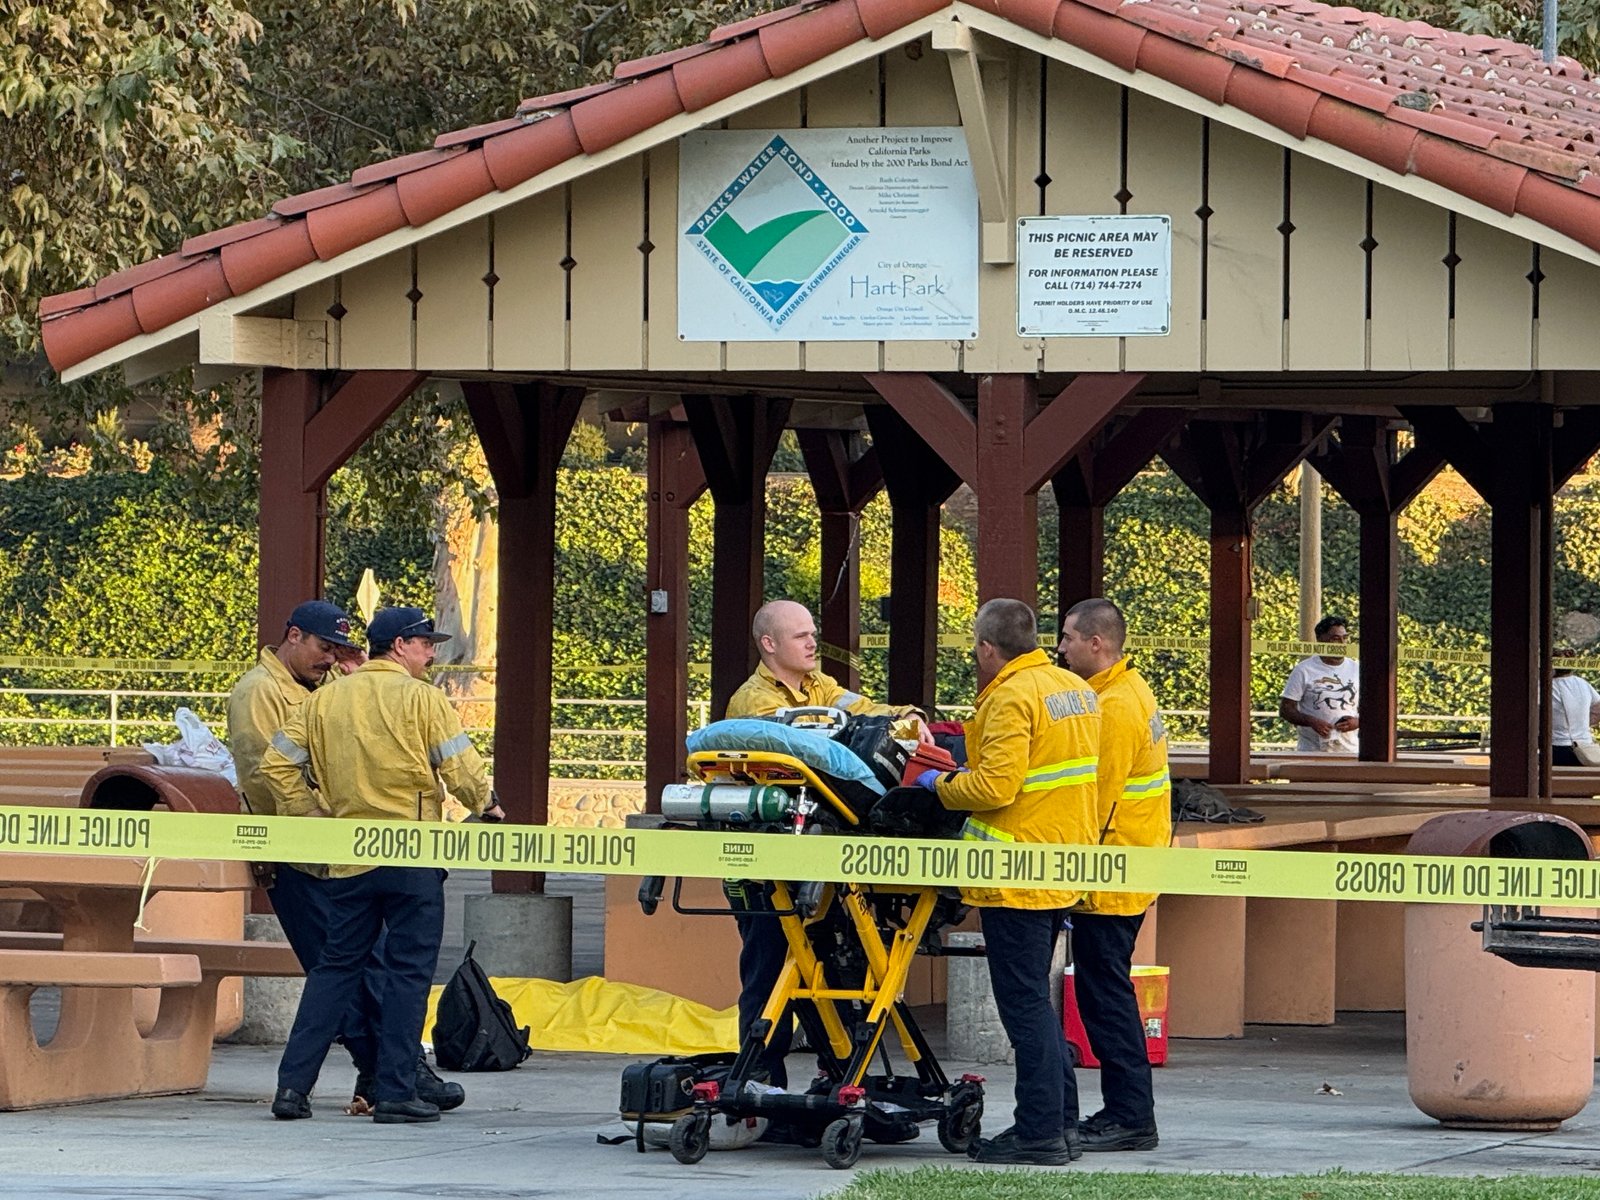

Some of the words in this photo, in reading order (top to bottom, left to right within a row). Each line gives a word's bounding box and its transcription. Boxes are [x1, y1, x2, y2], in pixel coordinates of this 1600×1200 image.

[847, 135, 879, 144] Another
[881, 134, 908, 145] Project
[910, 135, 919, 144] to
[921, 134, 952, 145] Improve
[868, 146, 907, 156] California
[909, 146, 931, 155] Parks
[831, 159, 858, 168] funded
[860, 159, 870, 169] by
[872, 159, 884, 168] the
[886, 159, 905, 167] 2000
[907, 158, 928, 167] Parks
[931, 158, 952, 167] Bond
[954, 158, 968, 167] Act
[696, 191, 734, 231] PARKS
[737, 146, 777, 187] WATER
[779, 145, 814, 182] BOND
[820, 190, 855, 227] 2000
[1028, 232, 1054, 243] THIS
[1056, 232, 1096, 243] PICNIC
[1098, 231, 1129, 242] AREA
[1132, 231, 1159, 242] MAY
[1054, 248, 1069, 258] BE
[1072, 247, 1133, 258] RESERVED
[877, 261, 892, 270] City
[893, 261, 901, 269] of
[902, 261, 928, 270] Orange
[1028, 268, 1048, 278] FOR
[1050, 268, 1118, 277] INFORMATION
[1120, 267, 1159, 277] PLEASE
[696, 240, 719, 264] STATE
[718, 262, 731, 276] OF
[730, 275, 774, 323] CALIFORNIA
[776, 290, 809, 326] GOVERNOR
[807, 235, 861, 293] SCHWARZENEGGER
[850, 274, 897, 298] Hart
[902, 274, 945, 298] Park
[1044, 281, 1069, 290] CALL
[1070, 280, 1096, 291] (714)
[1098, 280, 1142, 290] 744-7274
[866, 636, 887, 646] POLICE
[1131, 637, 1152, 647] POLICE
[1153, 638, 1166, 647] LINE
[1167, 638, 1176, 647] DO
[1267, 641, 1288, 652] POLICE
[1289, 643, 1302, 653] LINE
[1303, 644, 1312, 653] DO
[1313, 644, 1325, 654] NOT
[1327, 645, 1347, 656] CROSS
[1404, 648, 1425, 659] POLICE
[1426, 650, 1438, 660] LINE
[1440, 651, 1449, 661] DO
[1450, 651, 1462, 662] NOT
[1463, 652, 1484, 662] CROSS
